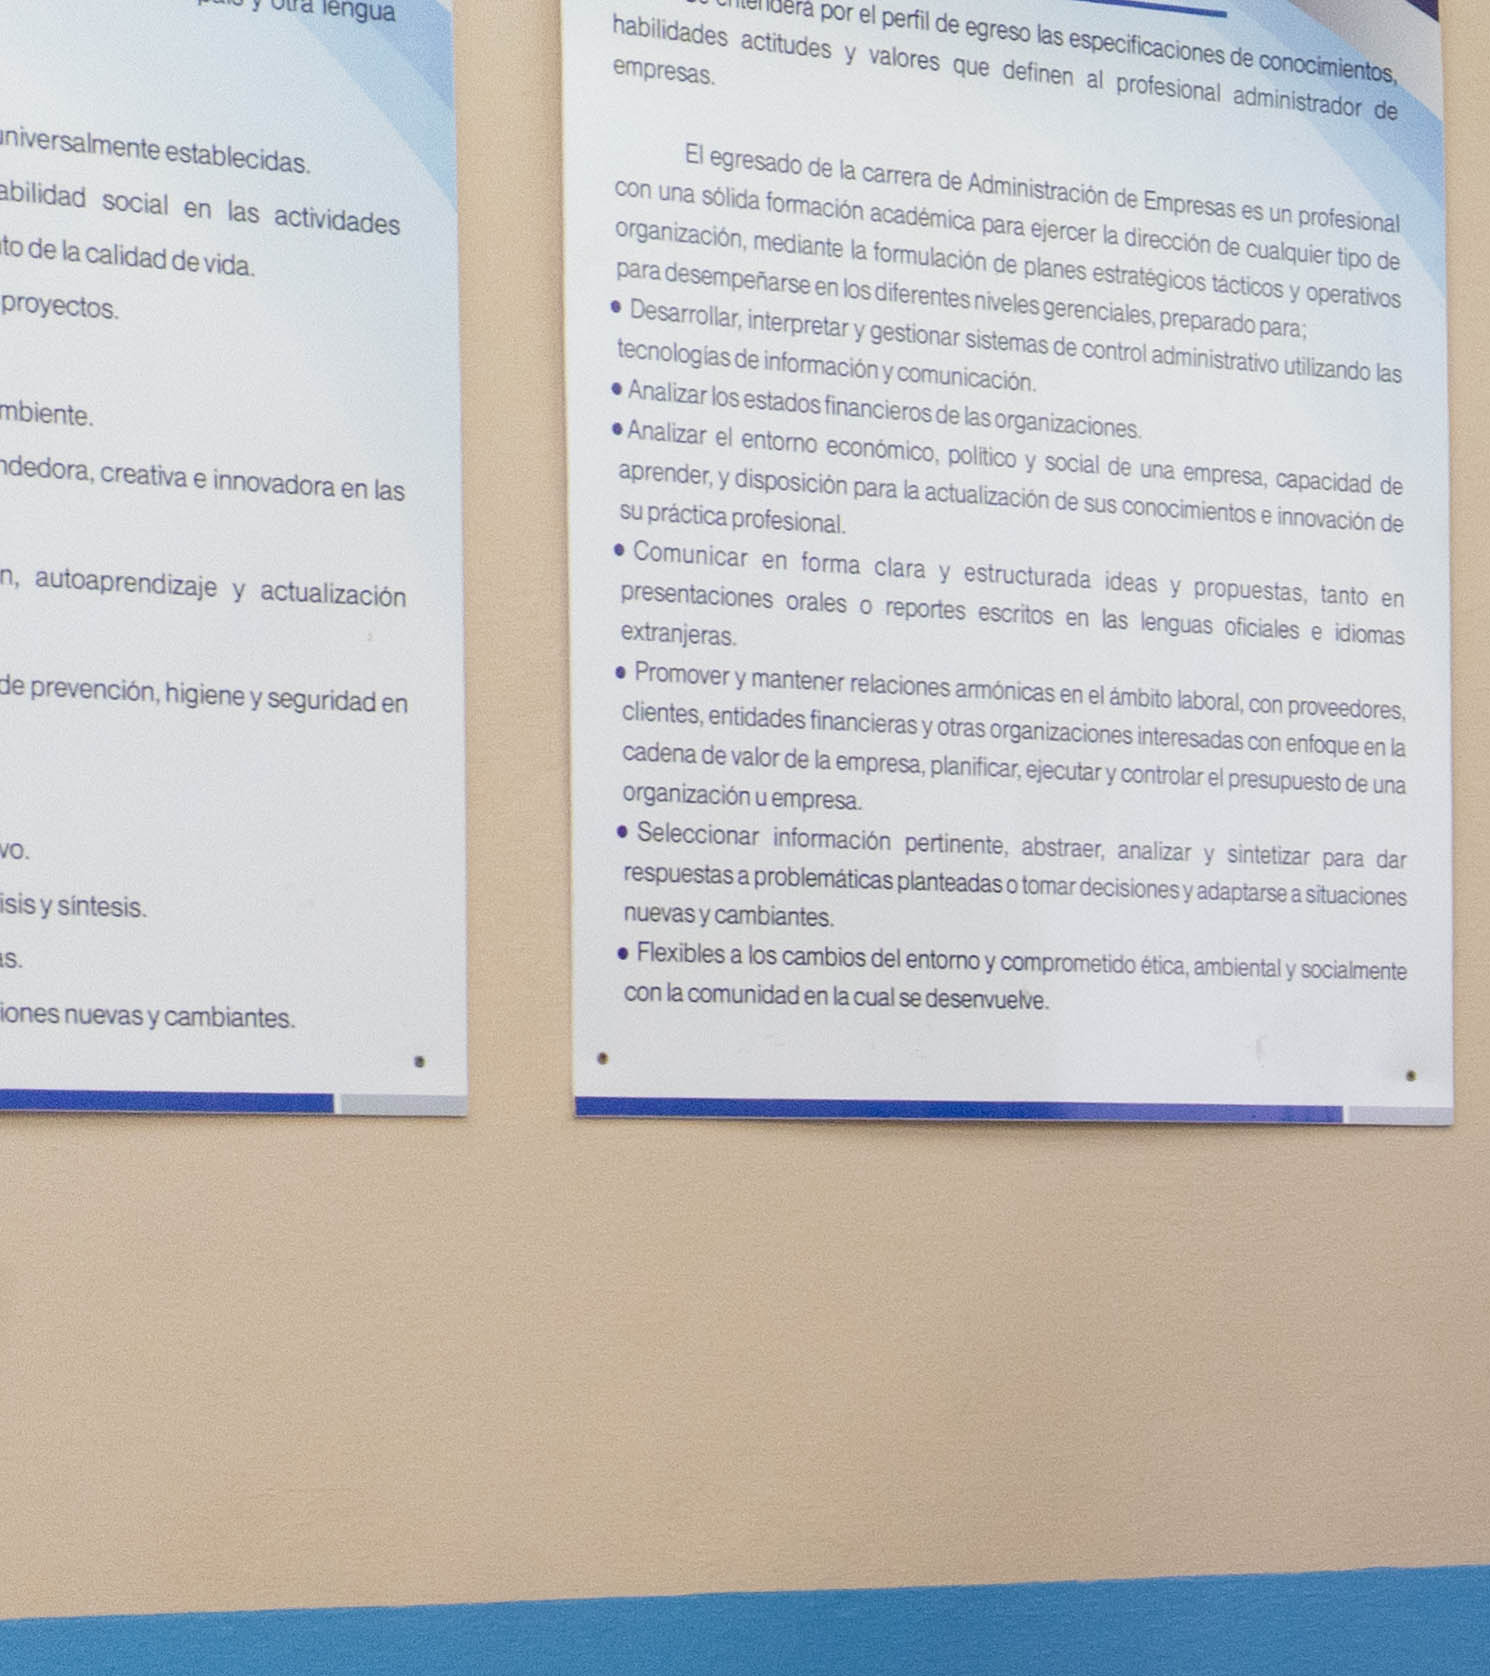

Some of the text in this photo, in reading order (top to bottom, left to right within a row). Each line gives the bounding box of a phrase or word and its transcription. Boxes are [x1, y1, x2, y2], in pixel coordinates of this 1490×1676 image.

[613, 12, 1398, 122] habilidades actitudes y valores que definen al profesional administrador de
[613, 58, 714, 86] empresas.
[165, 143, 310, 175] establecidas.
[103, 193, 400, 236] social en las actividades
[28, 237, 254, 277] de la calidad de vida.
[1, 294, 118, 320] proyectos.
[100, 464, 405, 502] creativa e innovadora en las
[35, 568, 406, 607] autoaprendizaje y actualización
[633, 539, 1404, 608] Comunicar en forma clara y estructurada ideas y propuestas, tanto en
[0, 673, 408, 715] de prevención, higiene y seguridad en
[34, 895, 146, 920] y síntesis.
[624, 982, 1048, 1011] con la comunidad en la cual se desenvuelve.
[65, 1006, 295, 1031] nuevas y cambiantes.
